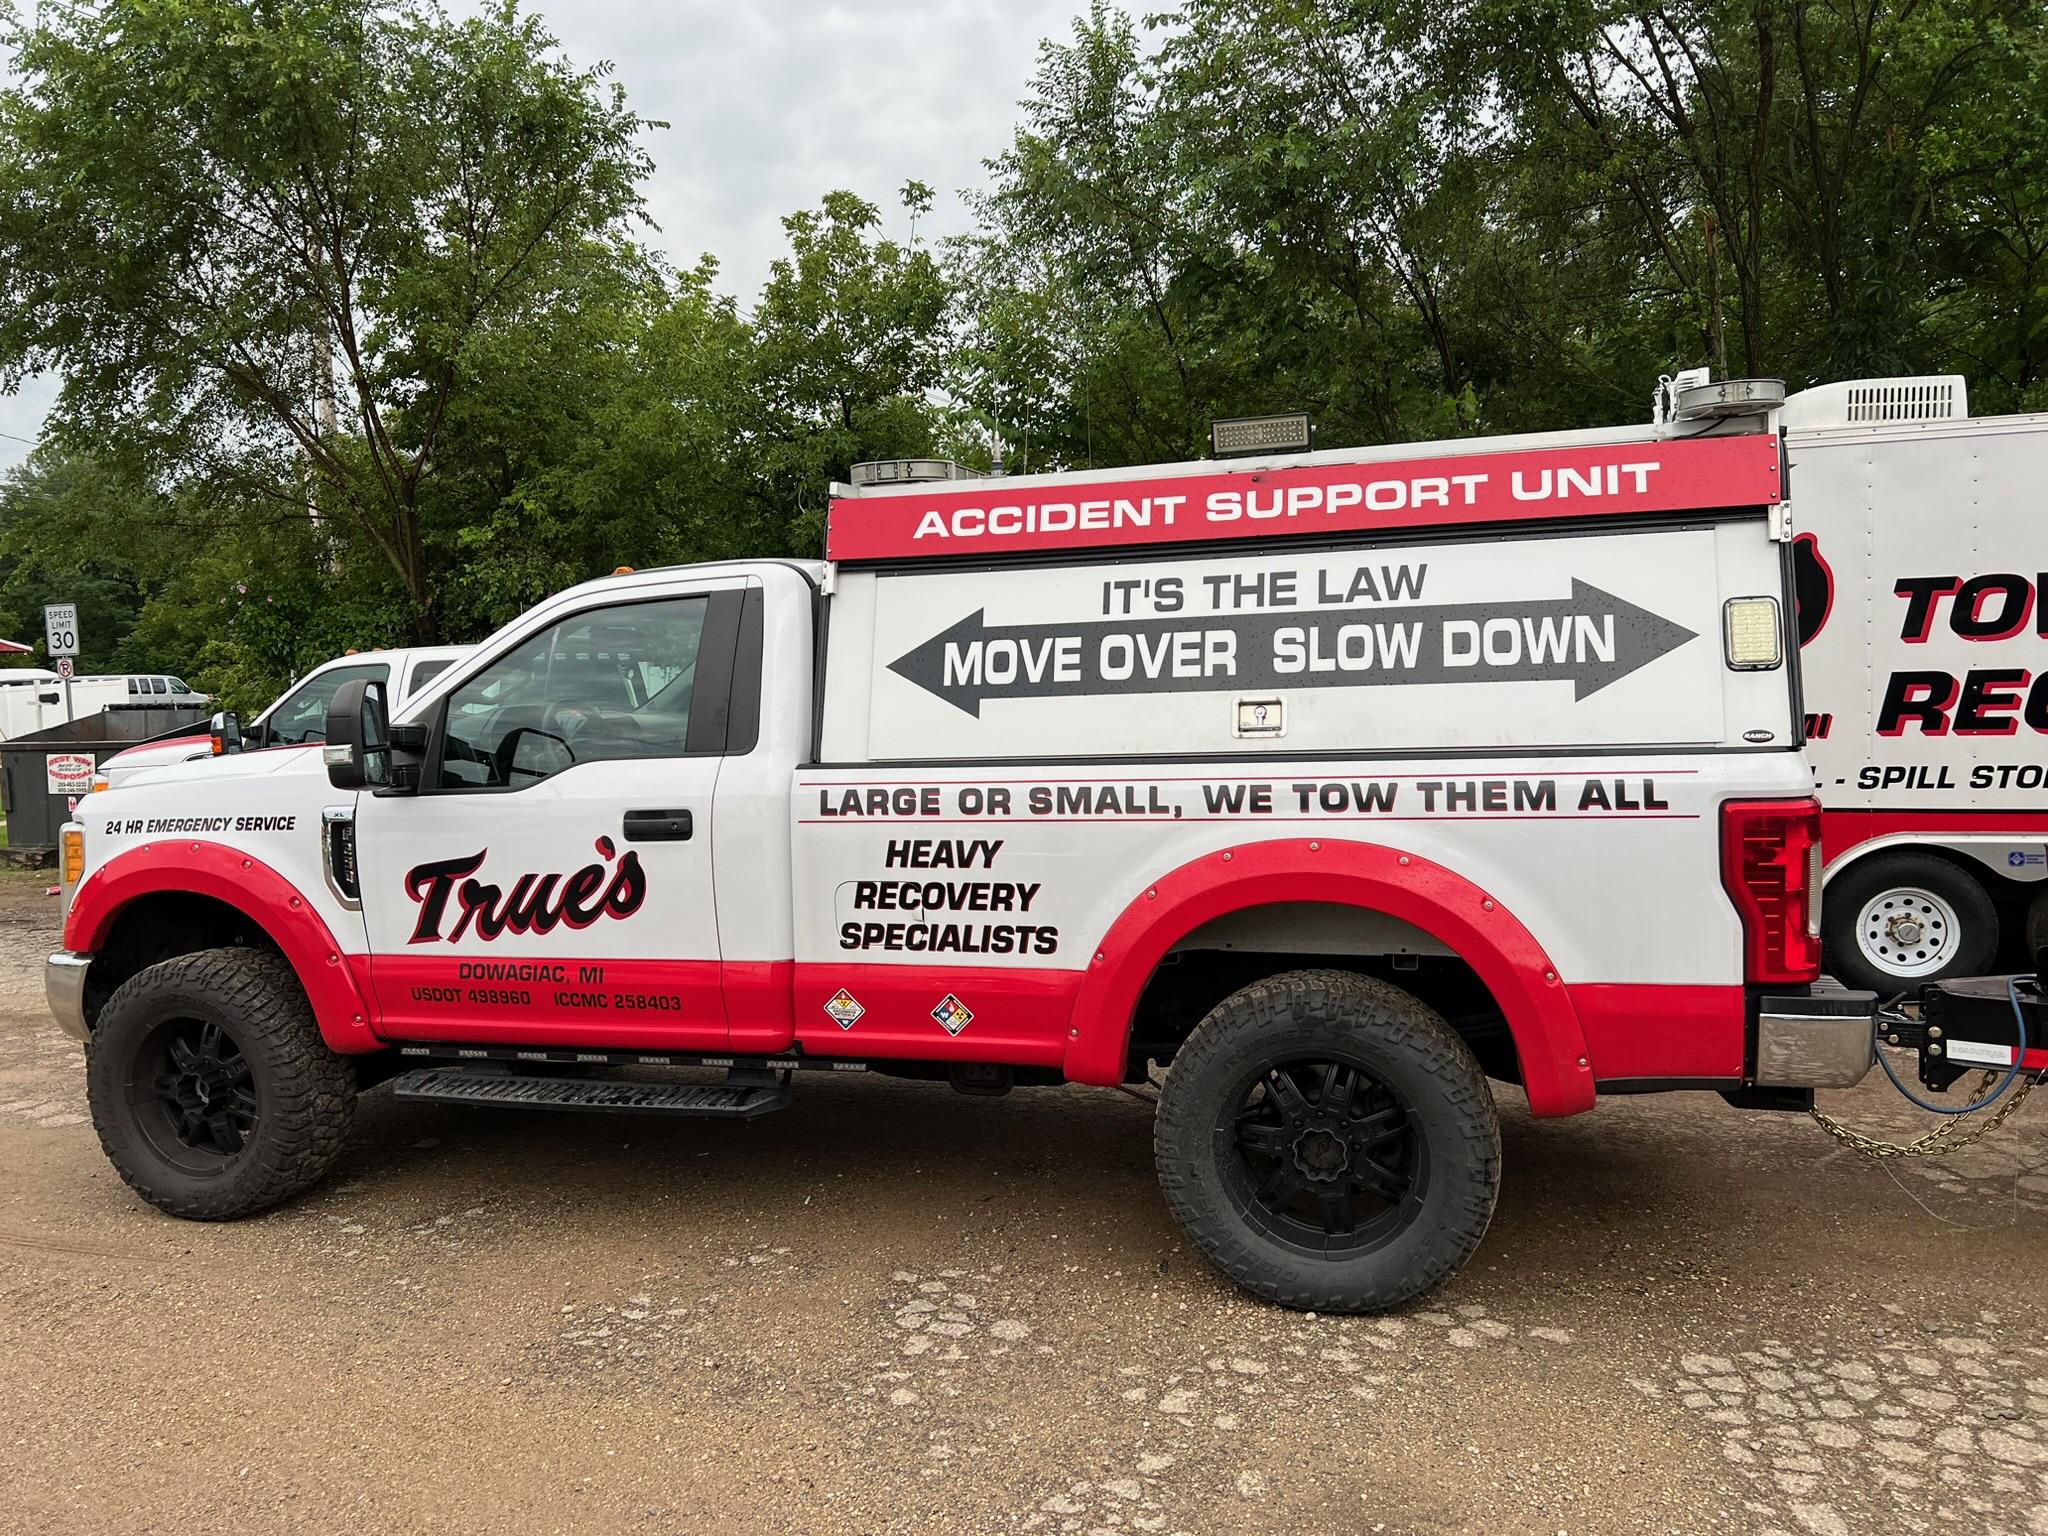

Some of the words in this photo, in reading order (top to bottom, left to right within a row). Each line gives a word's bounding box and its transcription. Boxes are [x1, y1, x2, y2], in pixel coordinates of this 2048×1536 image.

[912, 495, 1187, 540] ACCIDENT
[1205, 474, 1489, 522] SUPPORT
[1510, 461, 1661, 501] UNIT
[1102, 576, 1185, 615] IT'S
[1203, 570, 1298, 609] THE
[1318, 563, 1428, 604] LAW
[48, 610, 73, 619] SPEED
[1893, 572, 2048, 644] TO
[52, 620, 71, 629] LIMIT
[52, 631, 74, 649] 30
[943, 636, 1082, 687] MOVE
[1100, 629, 1237, 681] OVER
[1273, 622, 1424, 674] SLOW
[1442, 614, 1616, 668] DOWN
[49, 769, 93, 780] DISPOSAL
[1857, 765, 1955, 790] SPILL
[820, 787, 941, 816] LARGE
[958, 787, 1012, 816] OR
[1028, 785, 1183, 819] SMALL,
[1202, 784, 1273, 814] WE
[1292, 782, 1398, 813] TOW
[1416, 781, 1557, 813] THEM
[1577, 778, 1670, 811] ALL
[105, 820, 122, 835] 24
[125, 820, 143, 834] HR
[146, 817, 232, 834] EMERGENCY
[234, 816, 297, 832] SERVICE
[885, 839, 1004, 869] HEAVY
[405, 835, 647, 945] True's
[854, 881, 1042, 911] RECOVERY
[840, 923, 1058, 954] SPECIALISTS
[459, 962, 571, 986] DOWAGIAC,
[579, 967, 604, 984] MI
[411, 987, 462, 1004] USDOT
[467, 988, 531, 1006] 498960
[554, 991, 609, 1009] ICCMC
[614, 992, 682, 1011] 258403
